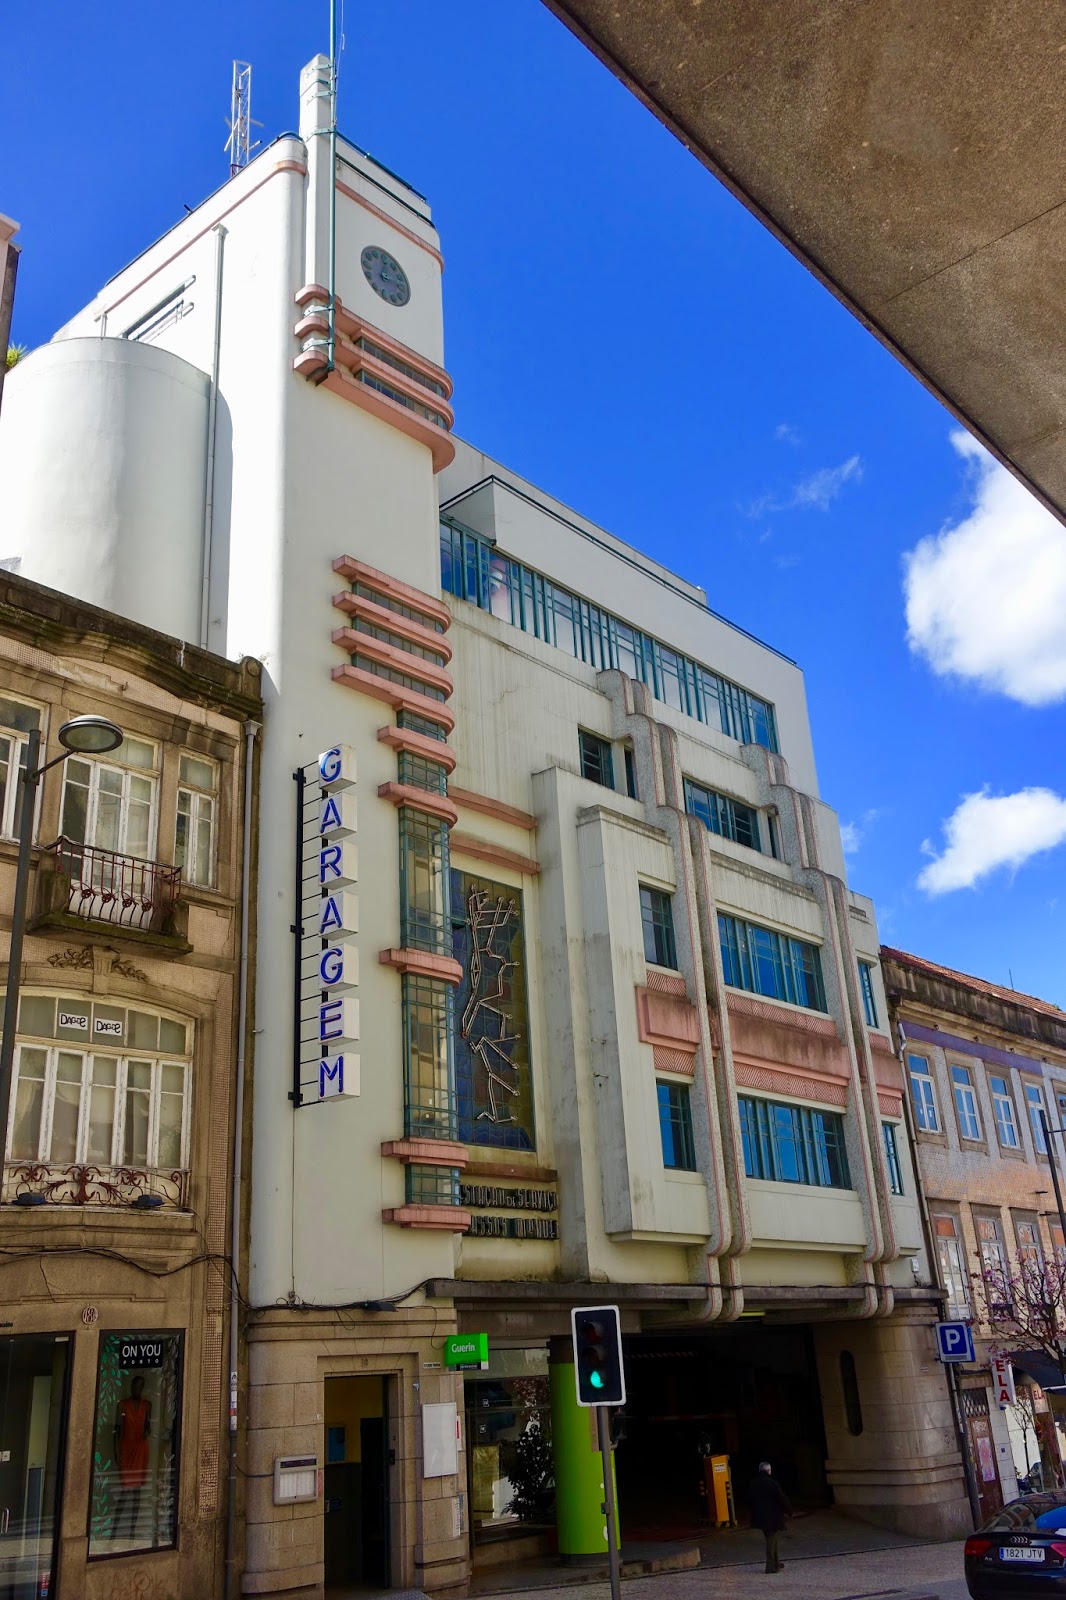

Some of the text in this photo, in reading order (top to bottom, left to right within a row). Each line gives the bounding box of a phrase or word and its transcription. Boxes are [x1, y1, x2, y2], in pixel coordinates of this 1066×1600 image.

[320, 749, 344, 1098] GARAGEM
[506, 1196, 516, 1207] DE
[944, 1329, 961, 1352] P
[122, 1344, 161, 1357] ON YOU
[451, 1342, 476, 1353] Guerin
[995, 1359, 1011, 1402] ELA
[1006, 1548, 1043, 1559] 1821 JTV
